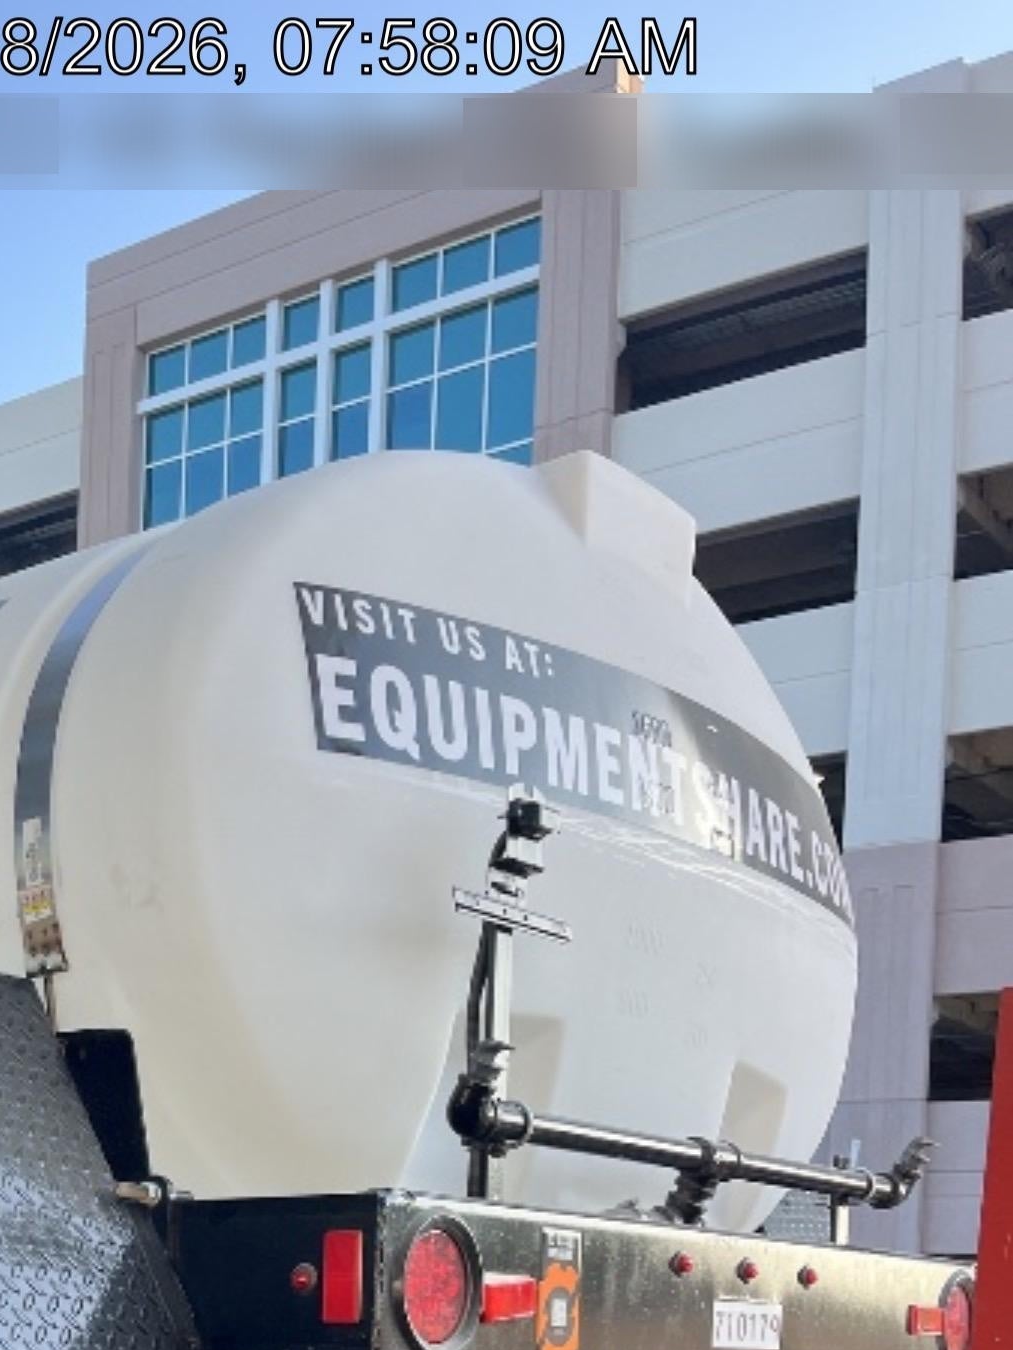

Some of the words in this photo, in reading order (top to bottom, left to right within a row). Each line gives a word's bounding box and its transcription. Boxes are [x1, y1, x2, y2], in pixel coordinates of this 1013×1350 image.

[300, 587, 416, 645] VISIT
[437, 616, 486, 661] US
[505, 635, 553, 678] AT:
[715, 1310, 781, 1342] 710179
